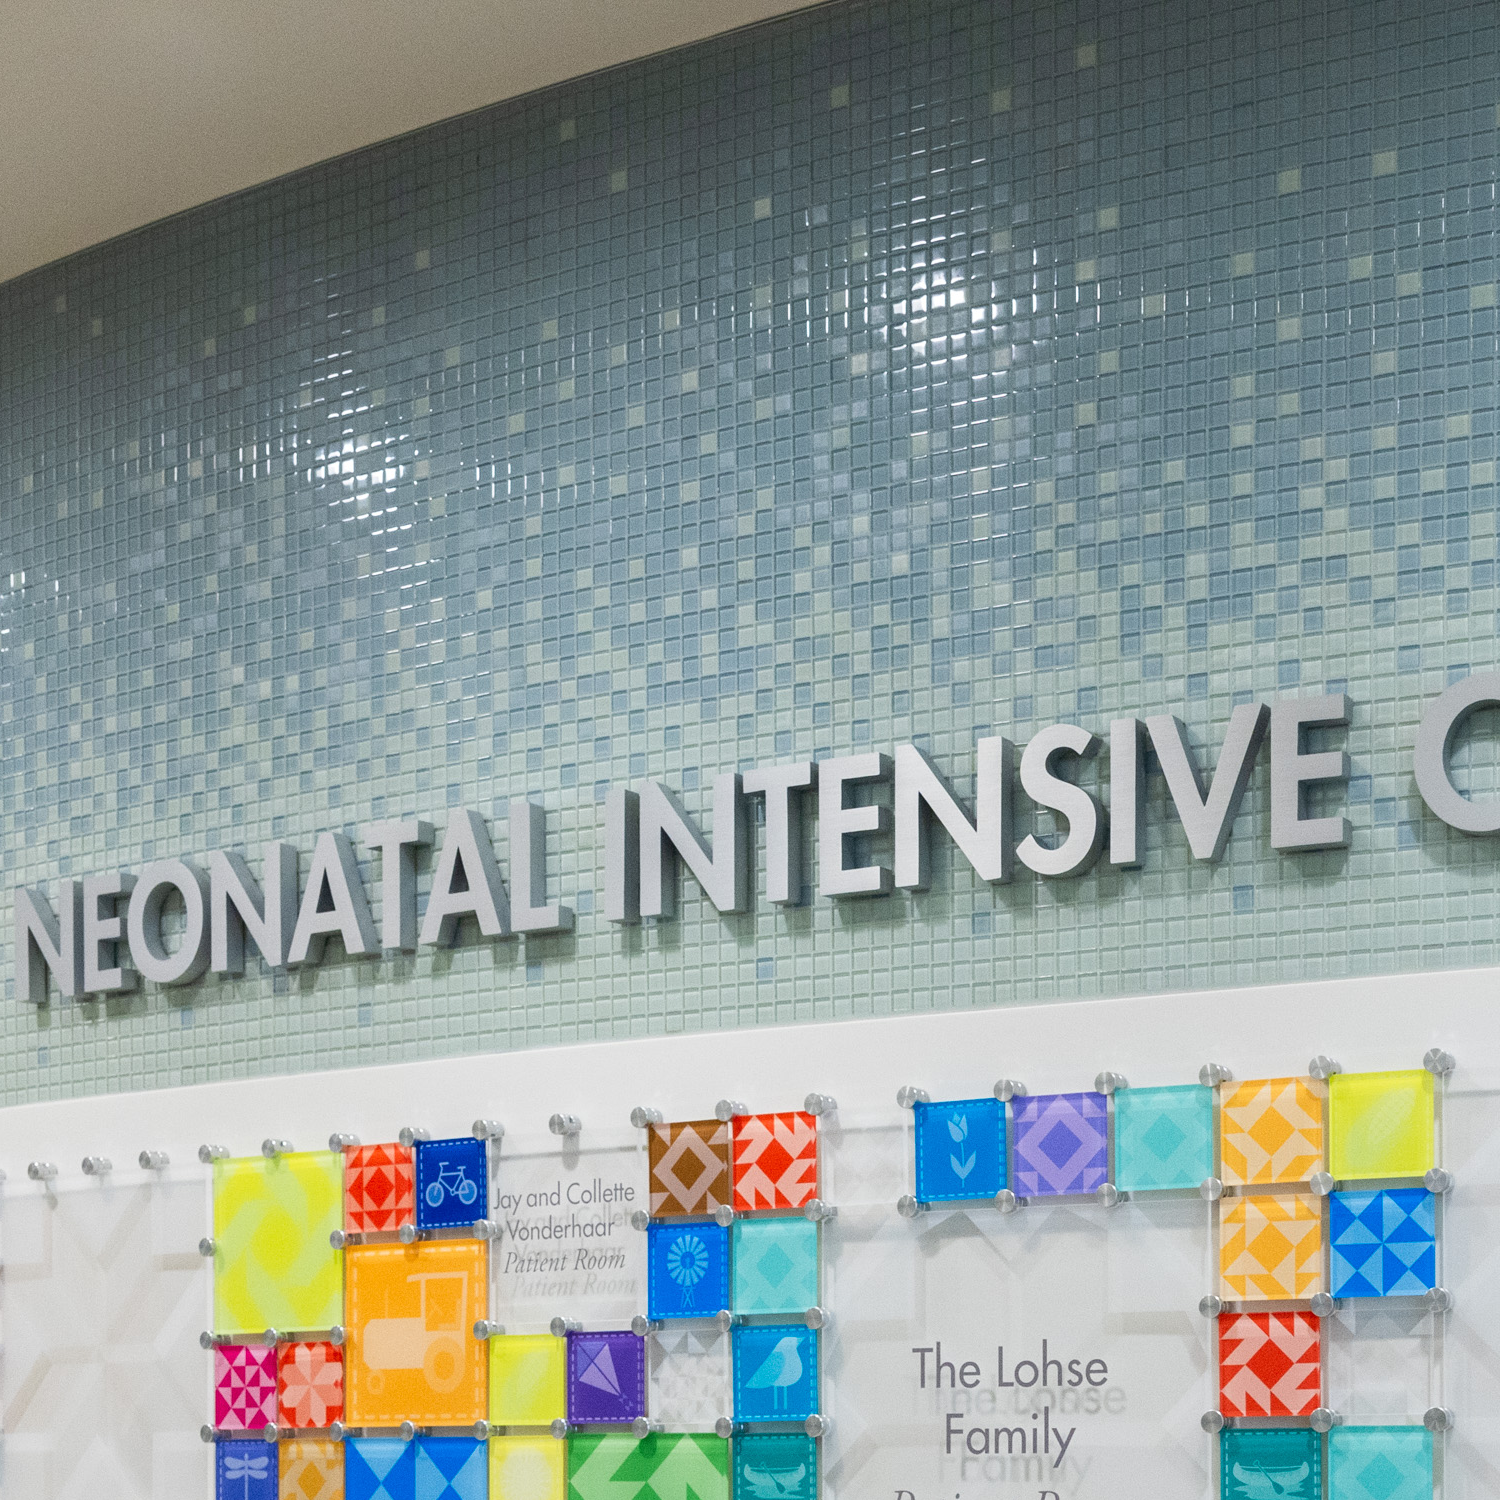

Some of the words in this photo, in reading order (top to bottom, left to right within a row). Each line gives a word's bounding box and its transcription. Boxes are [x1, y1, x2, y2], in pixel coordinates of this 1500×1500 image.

[14, 801, 574, 1003] NEONATAL
[606, 694, 1353, 924] INTENSIVE
[493, 1187, 523, 1216] Jay
[526, 1181, 561, 1208] and
[566, 1178, 635, 1205] Collette
[506, 1213, 616, 1242] Vonderhaar
[503, 1251, 569, 1275] Patient
[573, 1248, 626, 1272] Room
[911, 1341, 982, 1389] The
[997, 1339, 1110, 1388] Lohse
[945, 1406, 1077, 1469] Family
